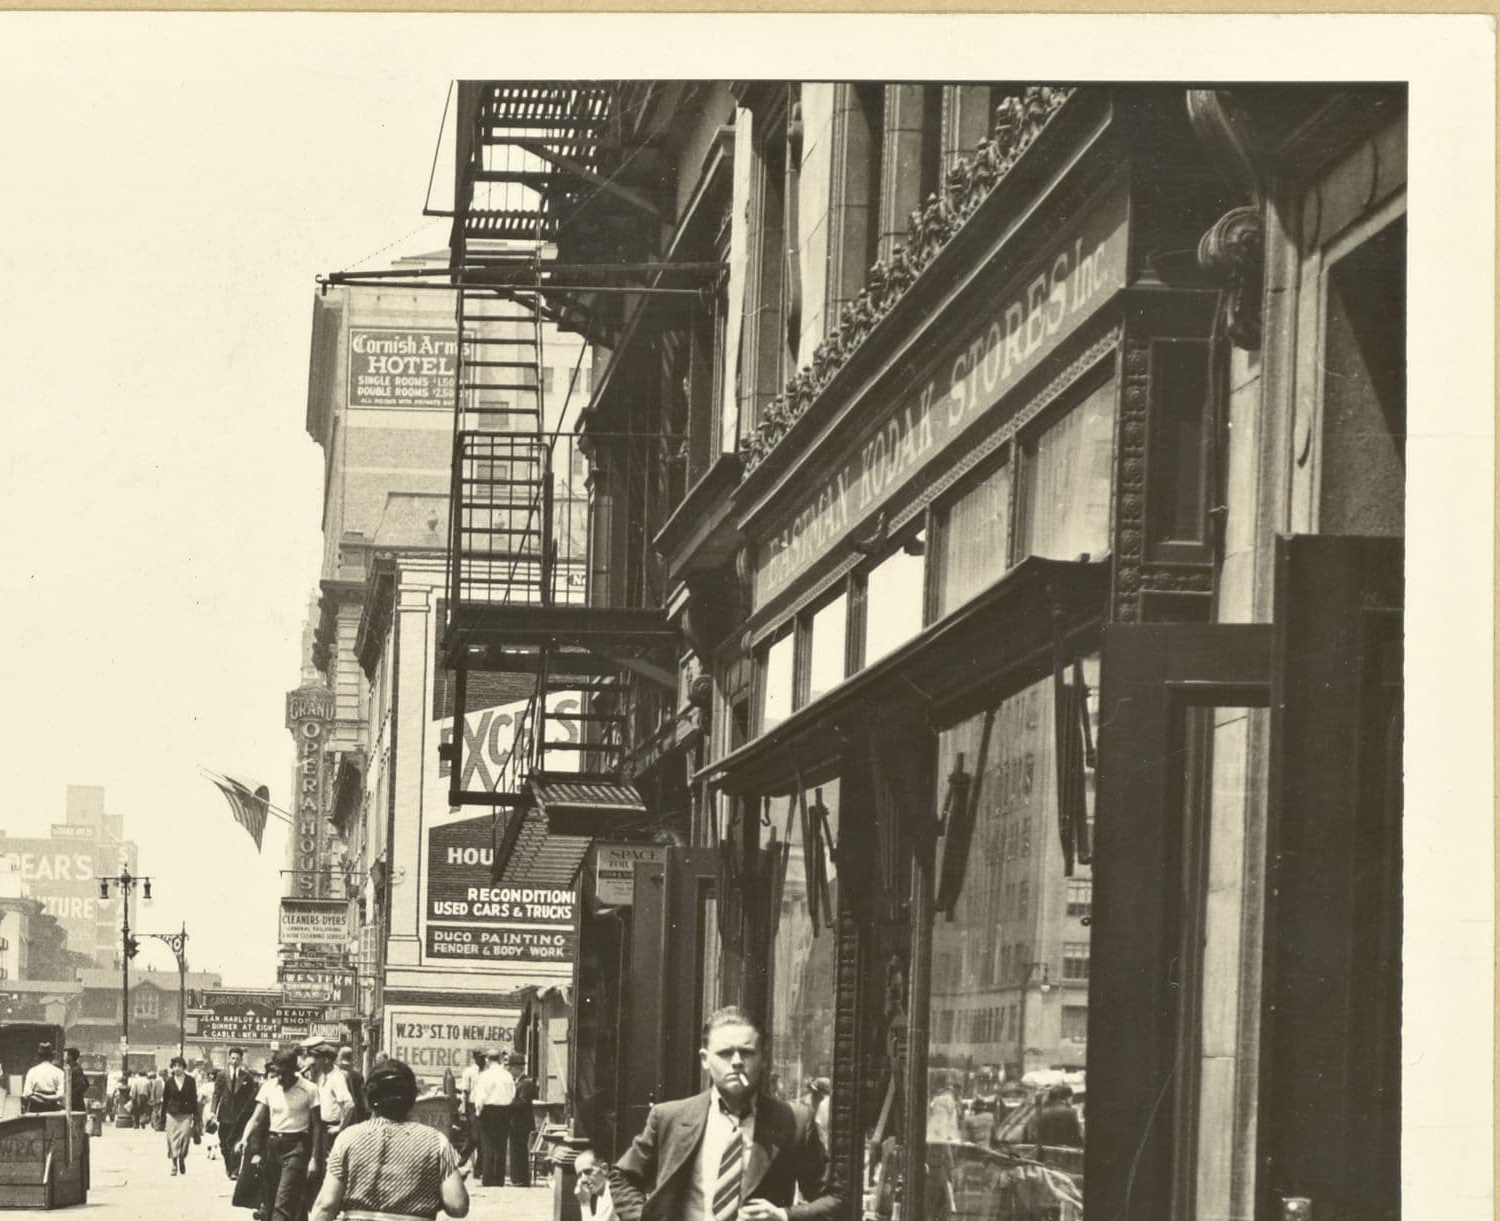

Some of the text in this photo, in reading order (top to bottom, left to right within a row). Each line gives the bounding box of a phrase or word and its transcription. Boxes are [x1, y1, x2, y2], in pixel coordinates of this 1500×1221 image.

[352, 334, 470, 356] Cornish Arms
[367, 356, 455, 375] HOTEL
[357, 375, 391, 386] SINGLE
[394, 376, 429, 387] ROOMS
[357, 386, 391, 397] DOUBLE
[394, 387, 429, 398] ROOMS
[766, 466, 851, 588] EASTMAN
[859, 380, 936, 510] KODAK
[947, 252, 1069, 427] STORES
[290, 701, 334, 721] GRAND
[302, 721, 321, 812] OPERA
[300, 821, 317, 899] HOUS
[448, 847, 494, 865] HOU
[433, 901, 572, 919] USED CARS & TRUCKS
[434, 931, 566, 946] DUCO PAINTING
[434, 943, 564, 957] FENDER & BODY WORK
[285, 974, 353, 986] WESTERN
[276, 1009, 320, 1017] BEAUTY
[463, 1025, 485, 1040] NEW
[395, 1046, 461, 1067] ELECTRIC
